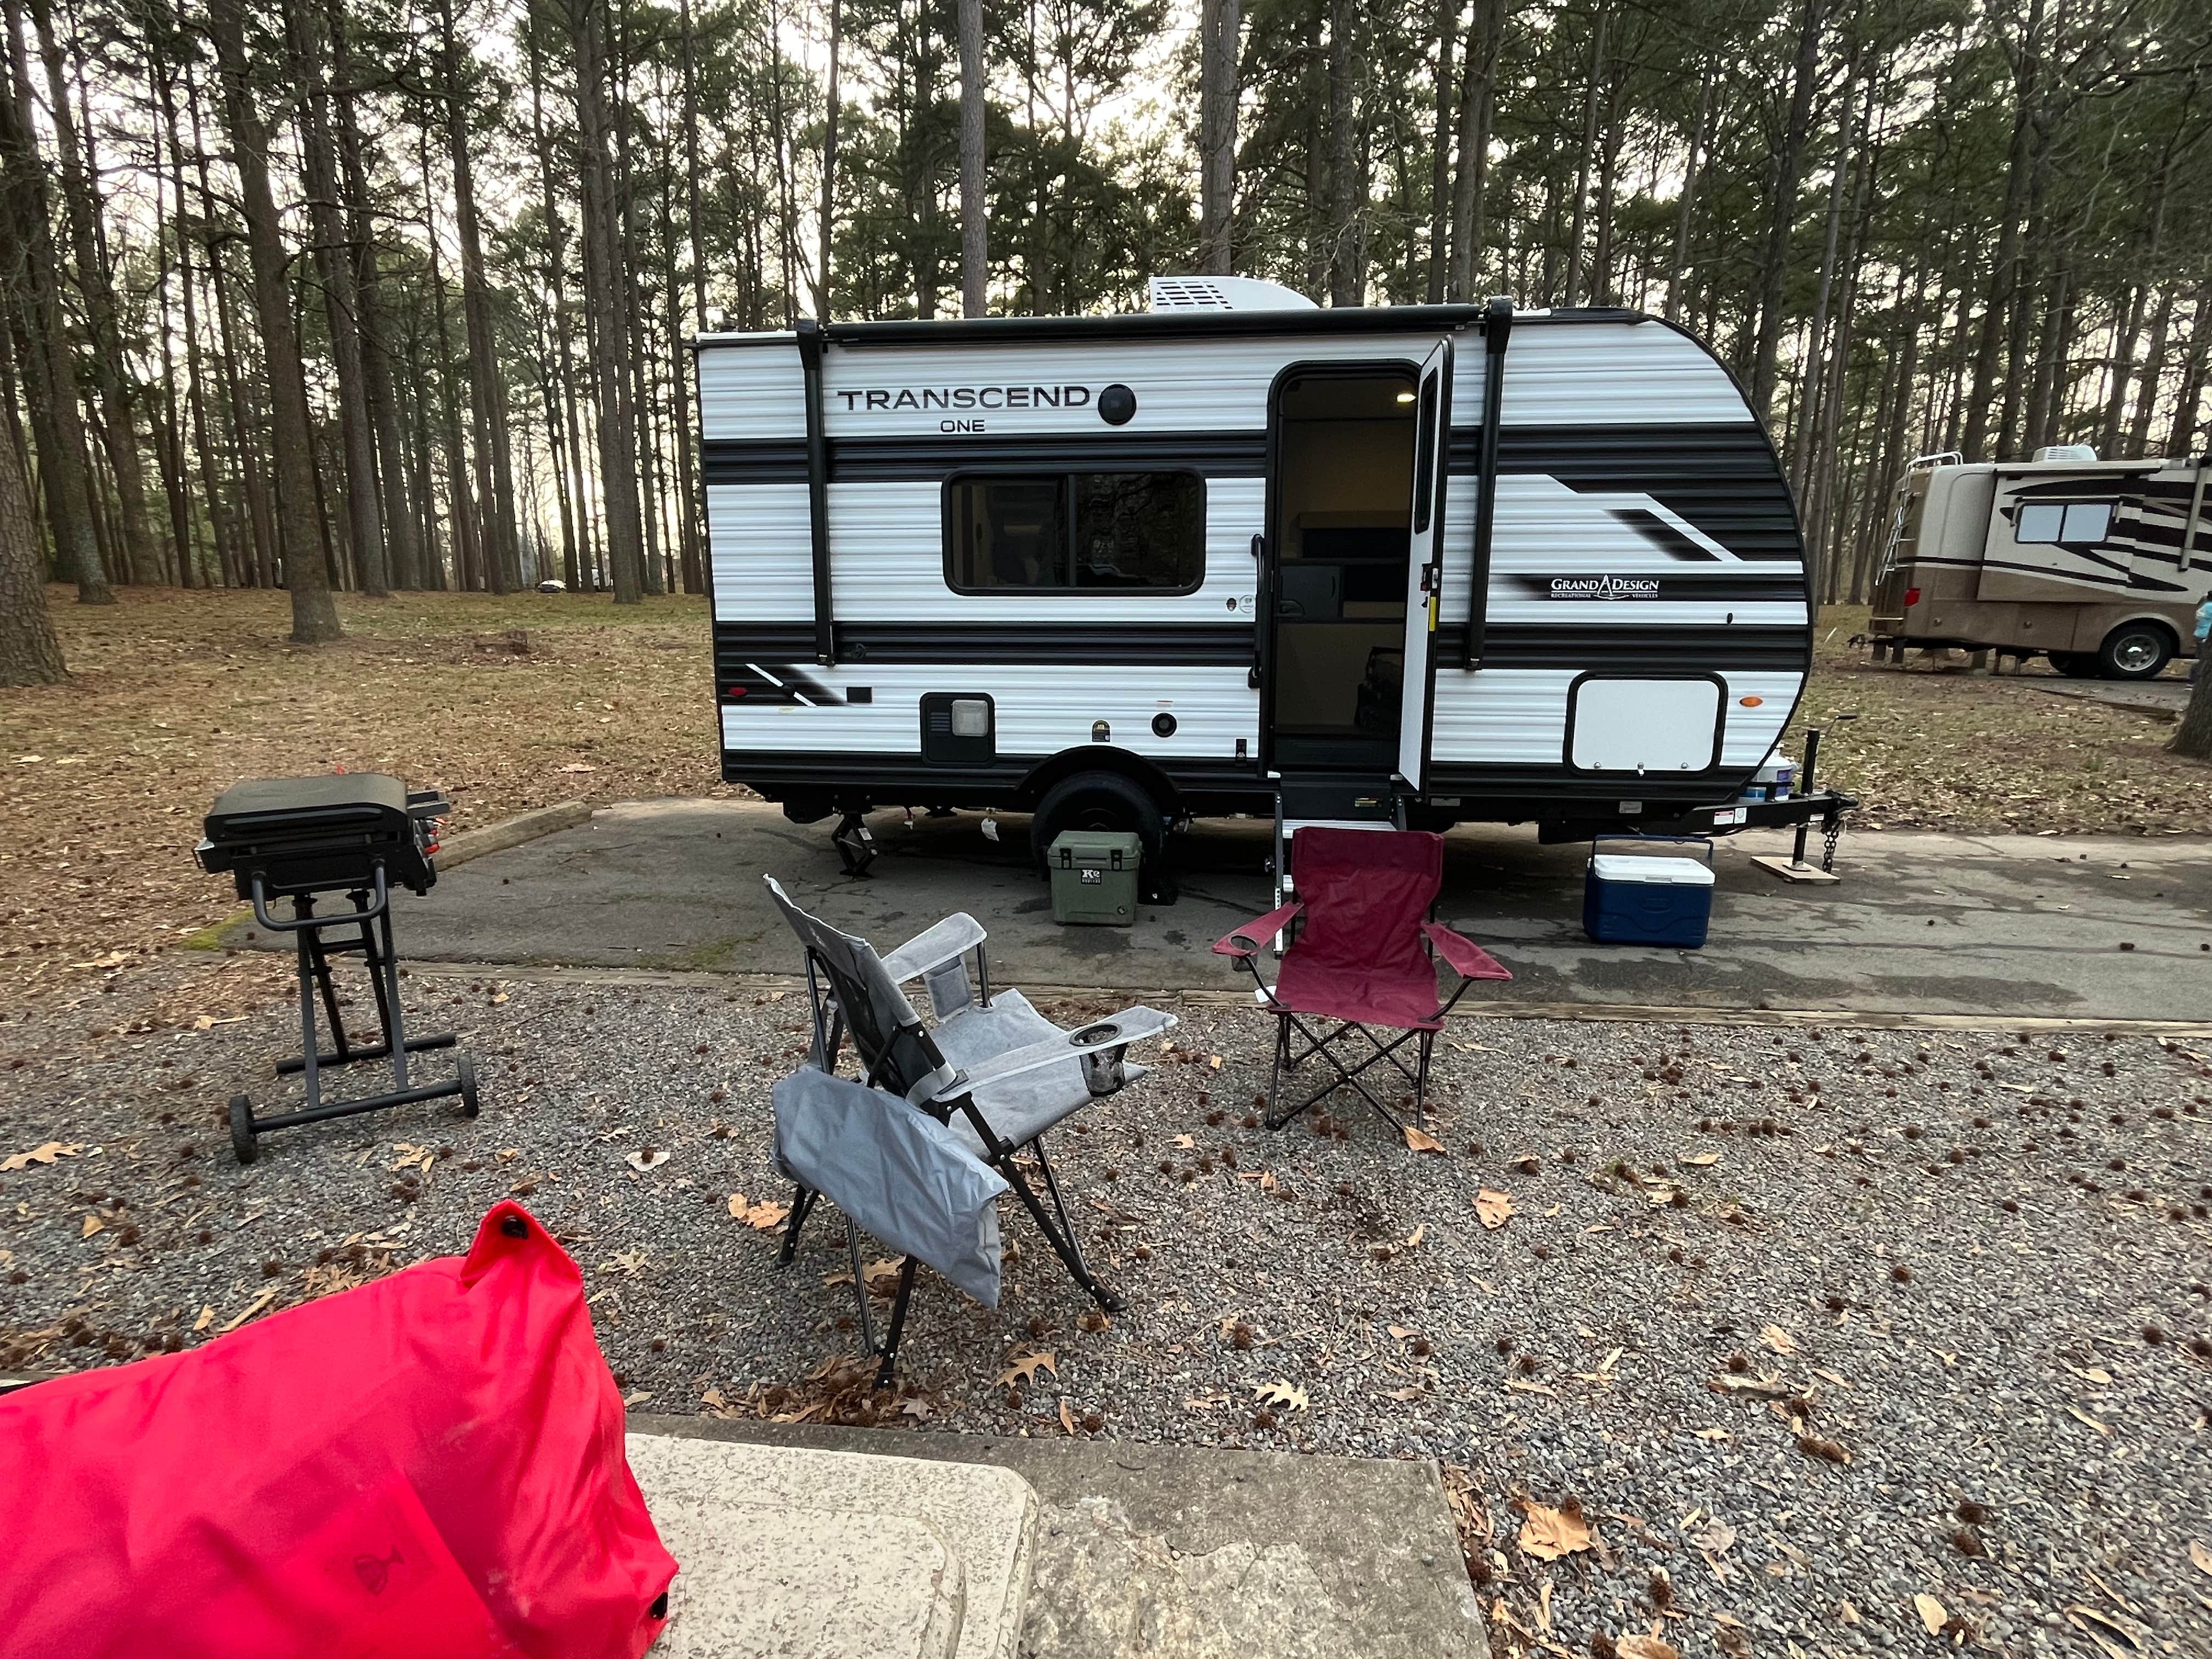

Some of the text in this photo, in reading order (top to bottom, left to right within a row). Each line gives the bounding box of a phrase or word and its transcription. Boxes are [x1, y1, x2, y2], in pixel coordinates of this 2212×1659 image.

[837, 386, 1090, 410] TRANSCEND
[940, 420, 985, 432] ONE
[1551, 578, 1660, 590] GRAND DESIGN
